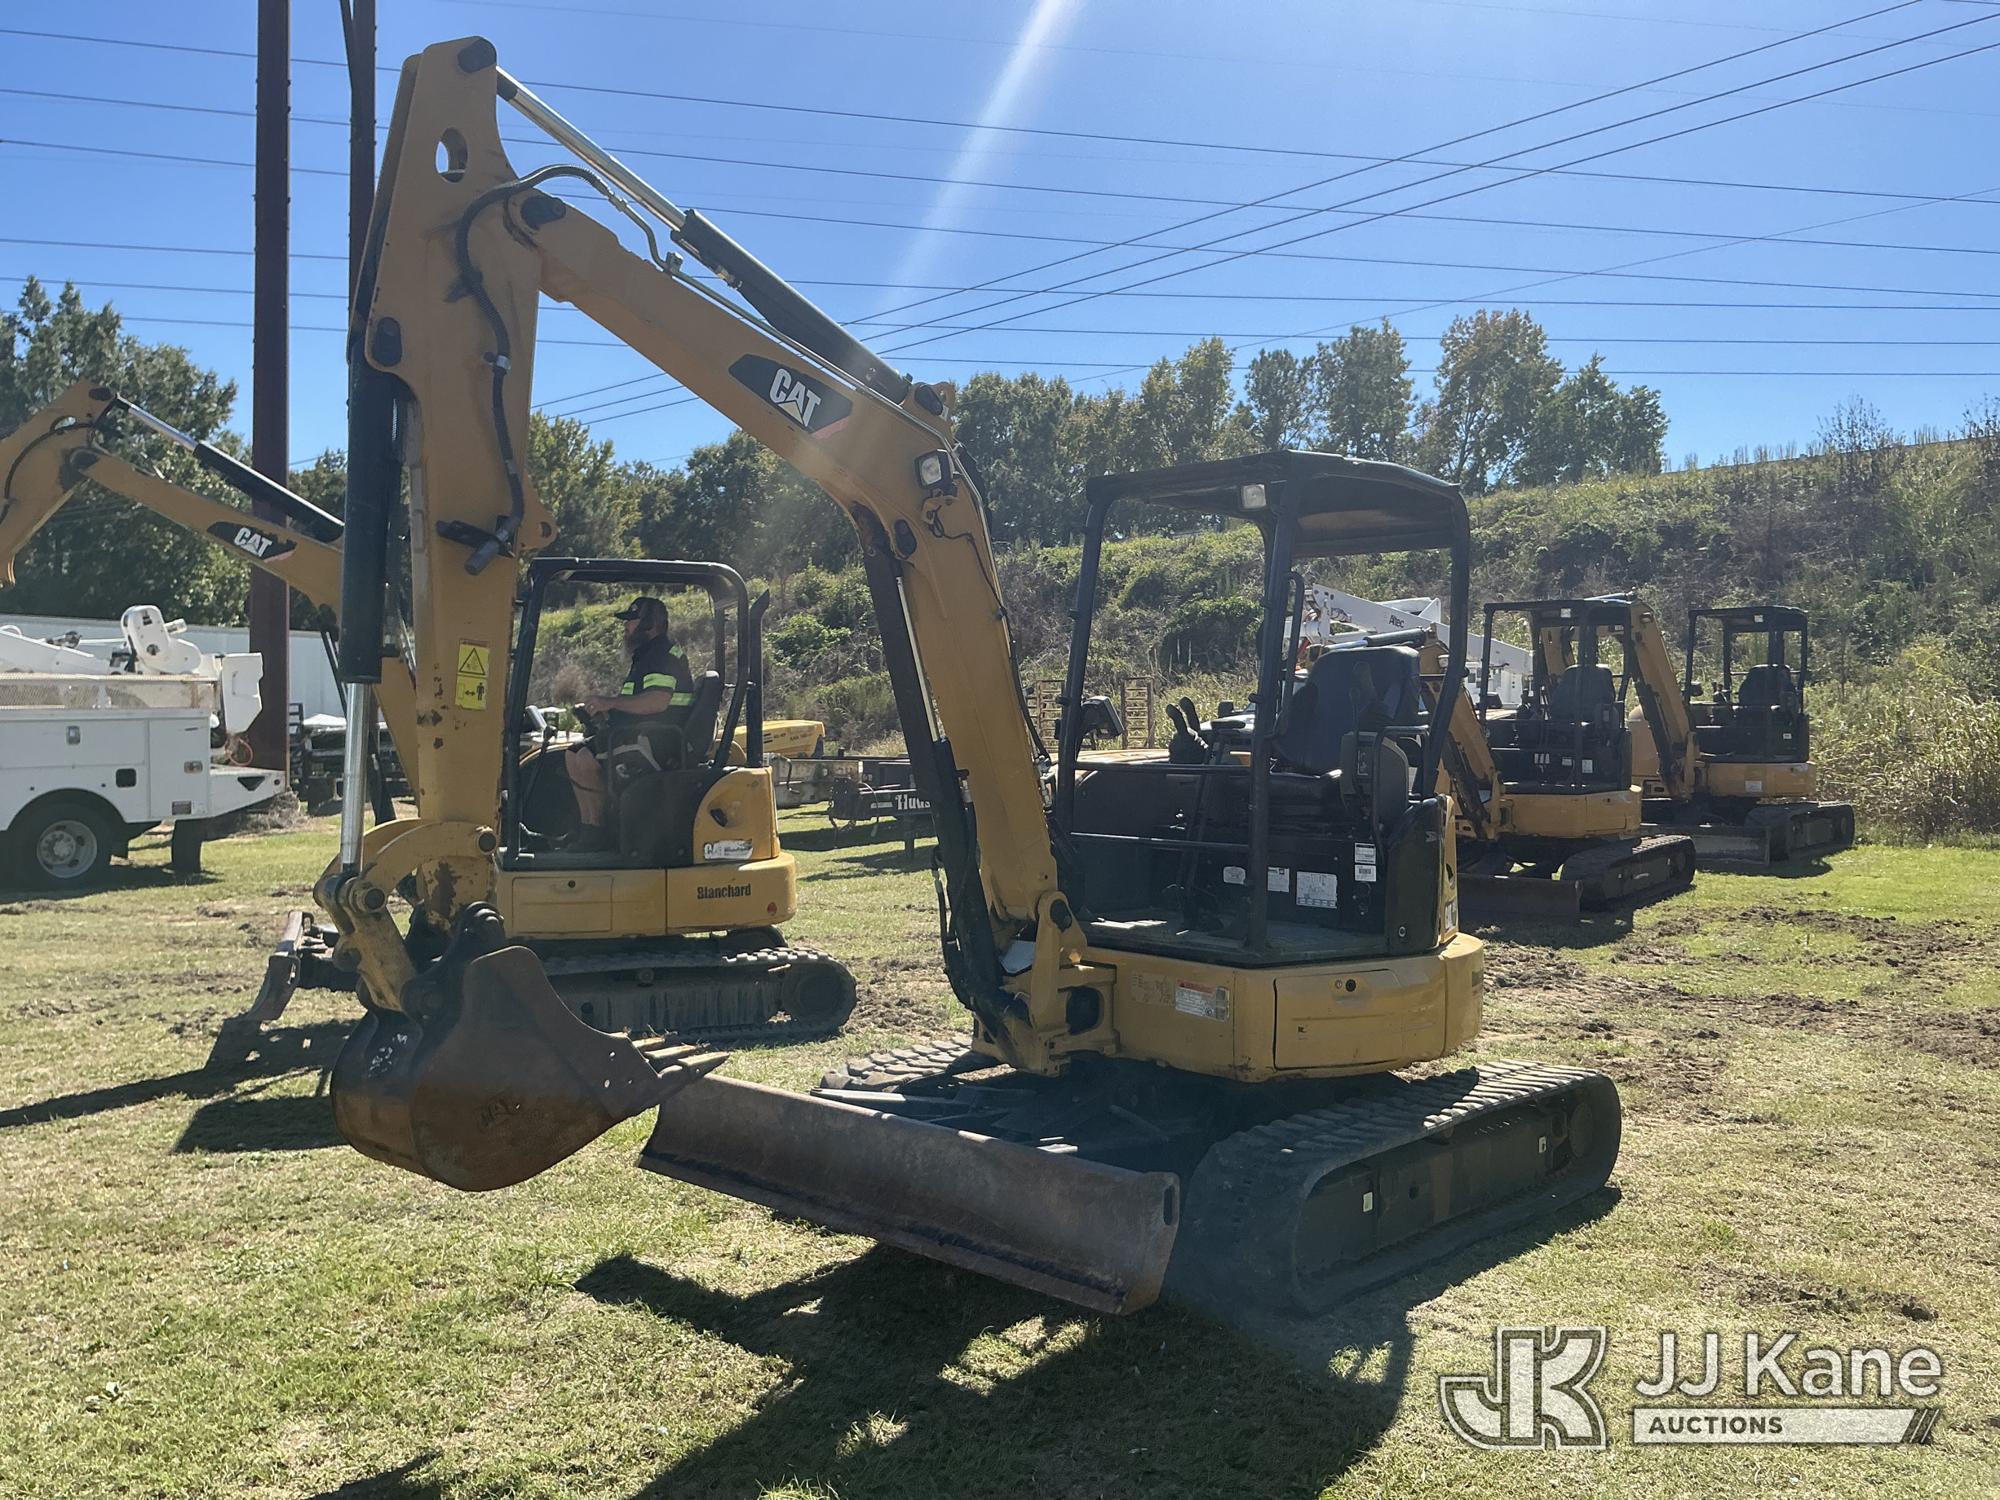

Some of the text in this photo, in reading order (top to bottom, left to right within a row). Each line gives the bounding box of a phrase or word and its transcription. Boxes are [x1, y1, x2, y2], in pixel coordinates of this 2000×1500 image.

[769, 368, 821, 427] CAT
[233, 527, 273, 557] CAT
[697, 883, 752, 899] Blanchard
